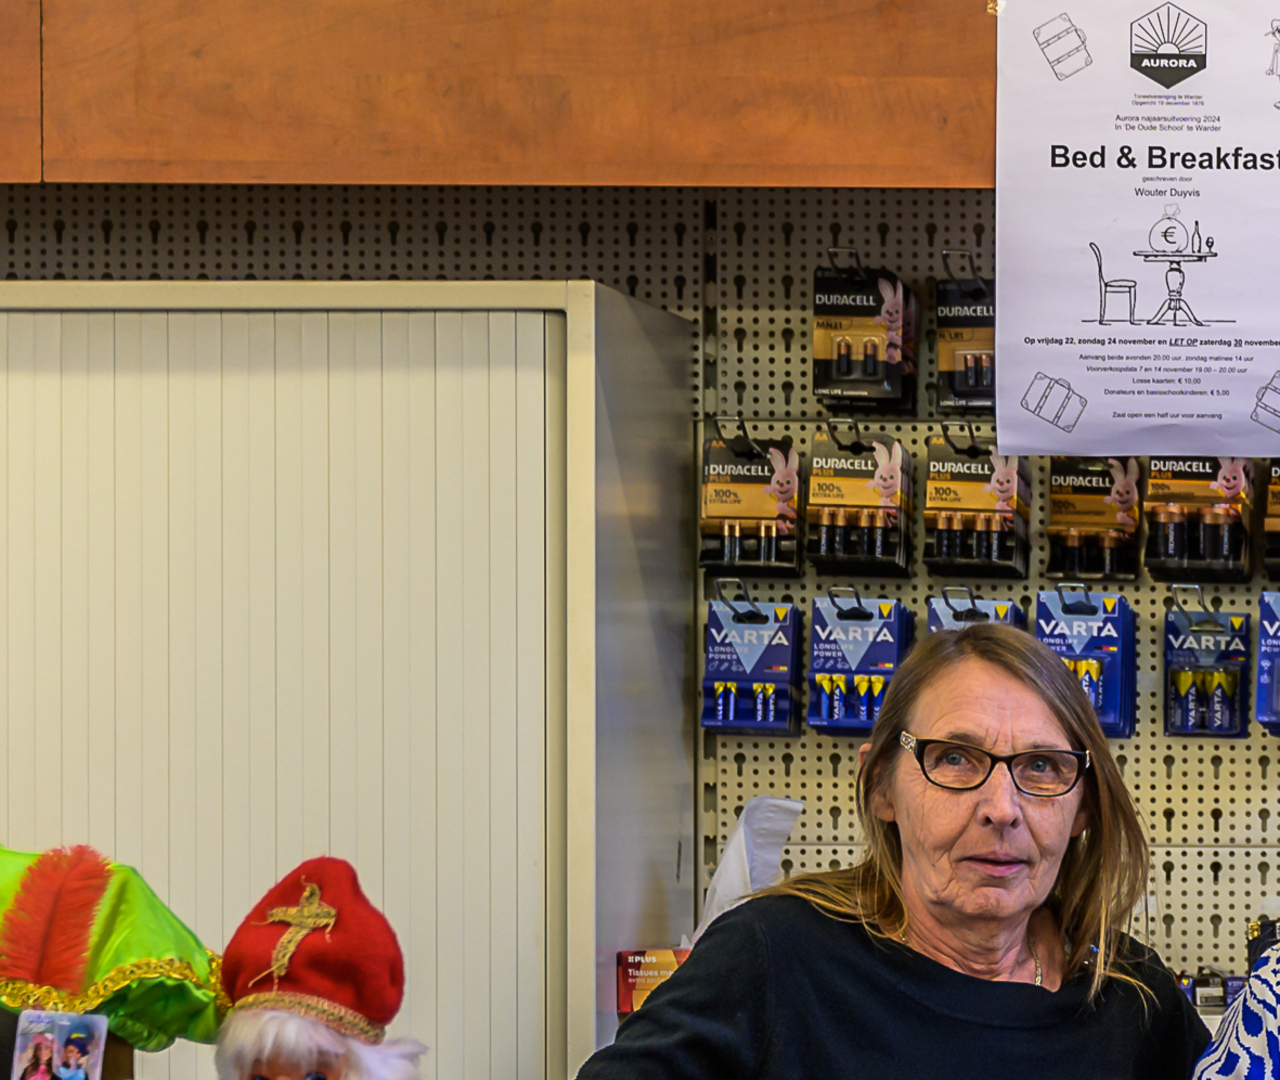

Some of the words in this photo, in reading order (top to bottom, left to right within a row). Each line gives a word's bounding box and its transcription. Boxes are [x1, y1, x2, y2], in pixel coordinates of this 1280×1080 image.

[1141, 58, 1197, 68] AURORA
[1141, 115, 1201, 123] najaarsuitvoering
[1051, 144, 1106, 168] Bed
[1116, 145, 1137, 169] &
[1135, 187, 1167, 197] Wouter
[1170, 188, 1201, 199] Duyvis
[816, 294, 876, 306] DURACELL
[938, 305, 995, 317] DURACELL
[1024, 336, 1035, 345] Op
[1037, 337, 1063, 346] vrijdag
[1065, 337, 1076, 345] 22,
[1078, 337, 1106, 346] zondag
[1107, 337, 1116, 345] 24
[1169, 338, 1184, 346] LET
[1186, 338, 1198, 346] OP
[1199, 339, 1232, 347] zaterdag
[1234, 339, 1243, 347] 30
[710, 464, 771, 476] DURACELL
[813, 458, 875, 471] DURACELL
[930, 461, 991, 474] DURACELL
[1151, 460, 1212, 473] DURACELL
[813, 469, 834, 477] PLUS
[930, 472, 951, 480] PLUS
[1151, 471, 1172, 479] PLUS
[1051, 475, 1112, 487] DURACELL
[714, 489, 738, 498] 100%
[817, 483, 842, 492] 100%
[934, 487, 959, 496] 100%
[814, 624, 894, 643] VARTA
[1038, 619, 1119, 638] VARTA
[710, 628, 789, 646] VARTA
[1168, 634, 1246, 651] VARTA
[814, 643, 854, 651] LONGLIFE
[814, 650, 843, 658] POWER
[1188, 686, 1196, 726] VARTA
[1213, 688, 1222, 727] VARTA
[628, 968, 658, 976] Tissues
